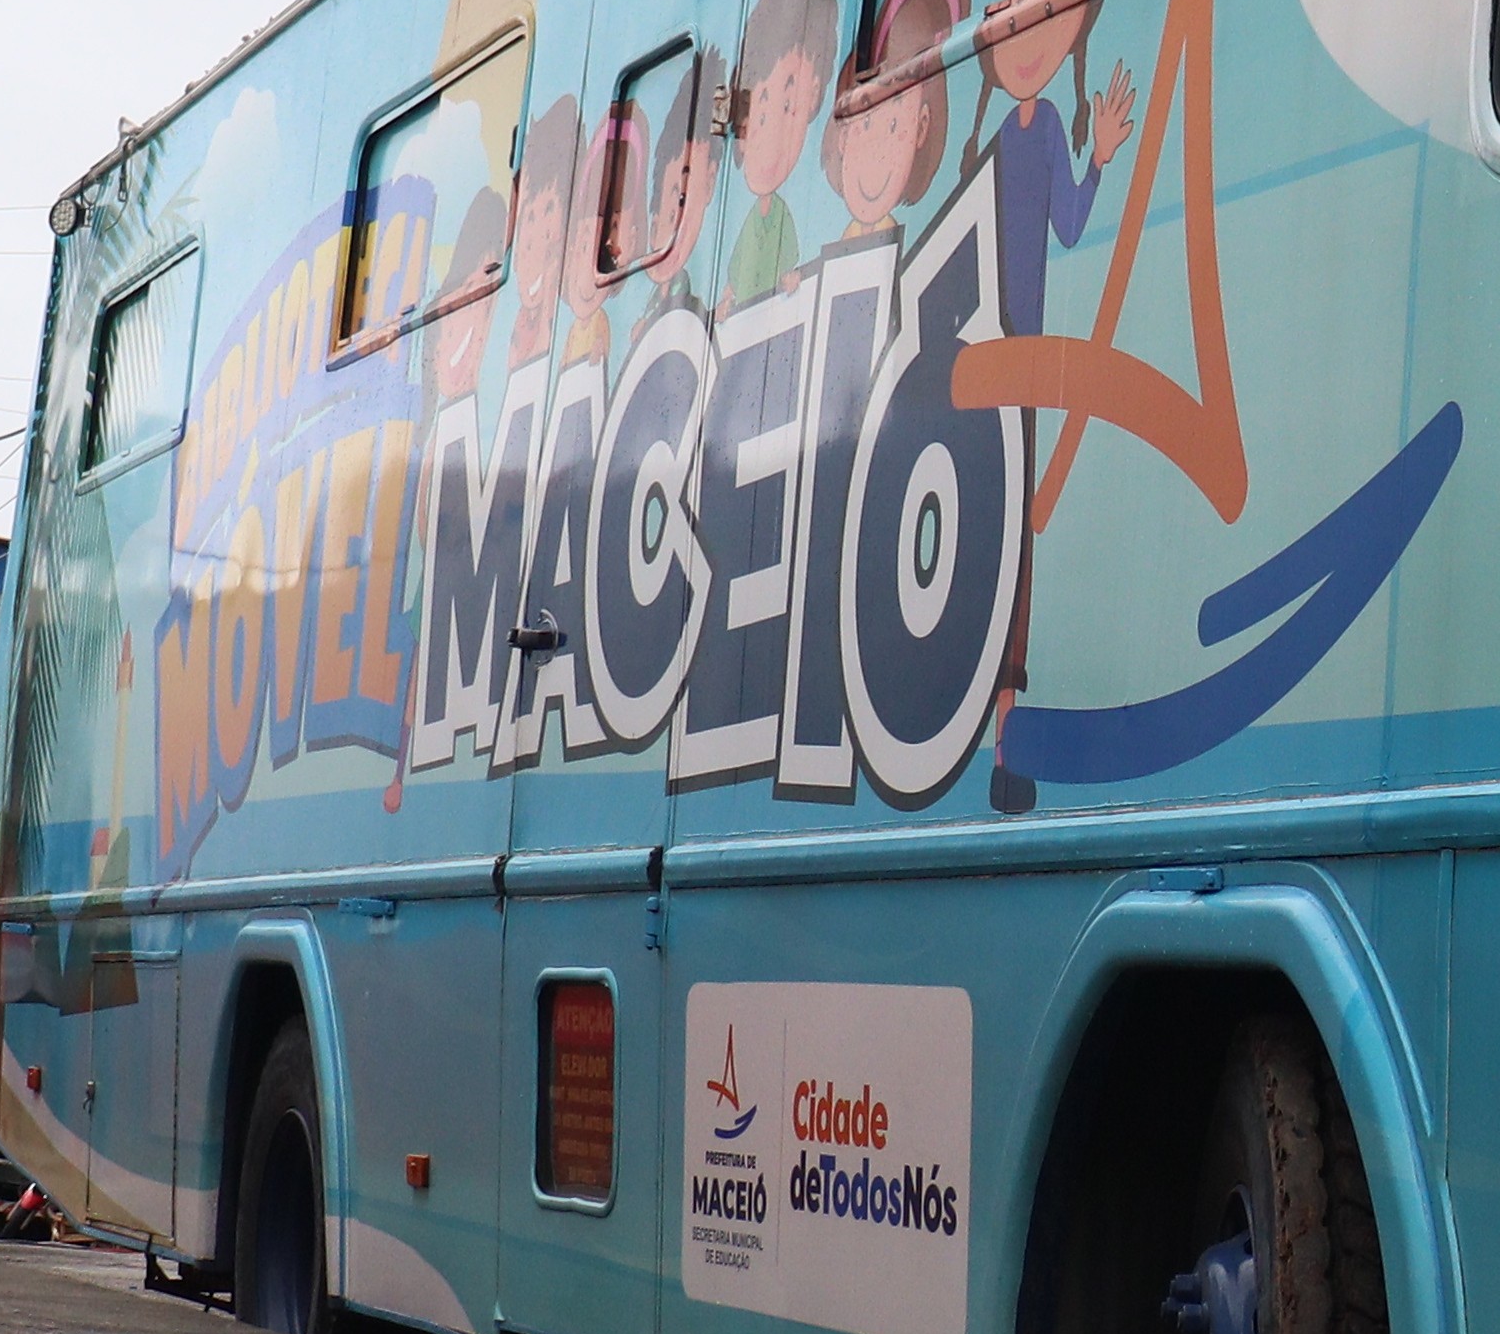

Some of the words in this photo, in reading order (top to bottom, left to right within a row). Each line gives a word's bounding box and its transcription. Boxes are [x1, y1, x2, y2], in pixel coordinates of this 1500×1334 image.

[175, 213, 430, 538] BIBLIOTECA
[411, 157, 1033, 800] MACEIÓ
[157, 419, 417, 859] MÓVEL
[792, 1079, 888, 1150] Cidade
[705, 1151, 745, 1168] PREFEITURA
[747, 1155, 757, 1169] DE
[790, 1150, 957, 1236] deTodosNós
[692, 1171, 767, 1224] MACEIÓ
[692, 1226, 730, 1245] SECRETARIA
[705, 1248, 715, 1264] DE
[715, 1250, 750, 1272] EDUCAÇÃO
